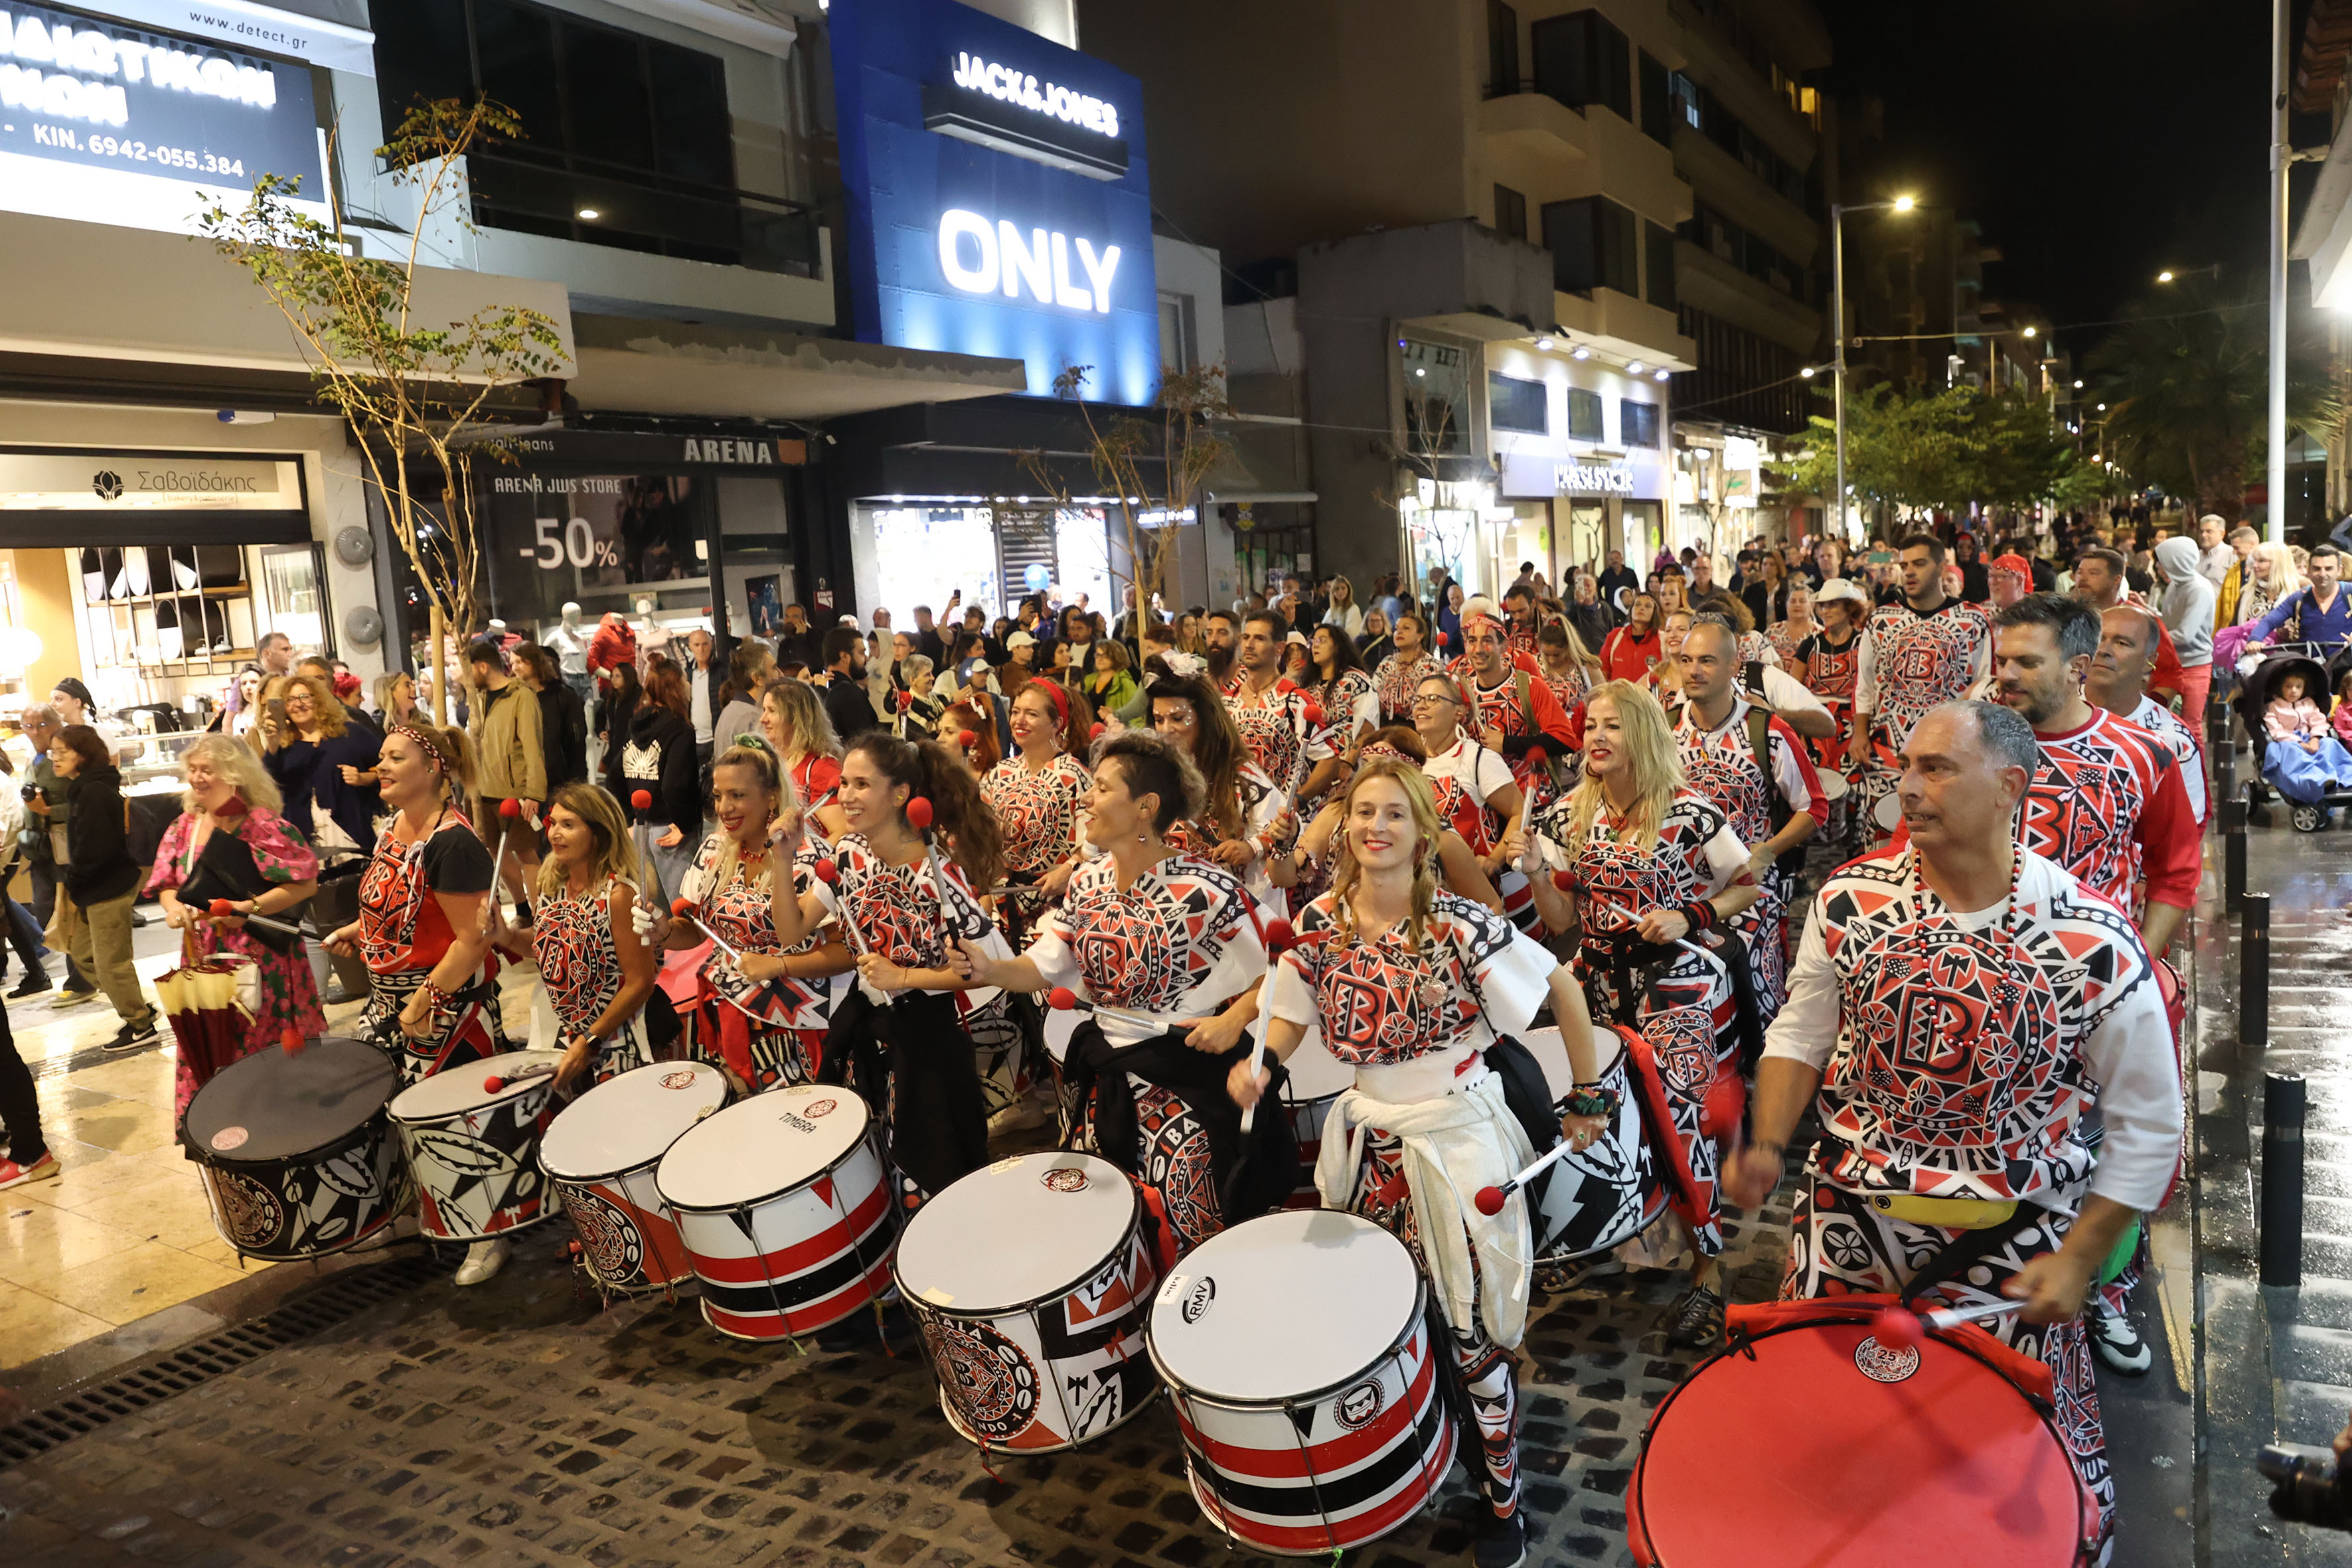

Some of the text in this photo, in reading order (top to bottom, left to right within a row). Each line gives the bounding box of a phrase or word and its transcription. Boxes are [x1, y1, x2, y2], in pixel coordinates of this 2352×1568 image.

[190, 11, 307, 49] www.detect.gr
[88, 134, 244, 177] 6942-055.384
[939, 208, 1121, 313] ONLY
[684, 438, 772, 464] ARENA
[137, 471, 257, 493] Σαβοϊδάκης
[495, 477, 621, 494] ARENA JWS STORE
[519, 518, 618, 570] -50%
[779, 1112, 817, 1134] TIMBRA
[1189, 1284, 1208, 1316] RMV
[1877, 1350, 1897, 1362] 25
